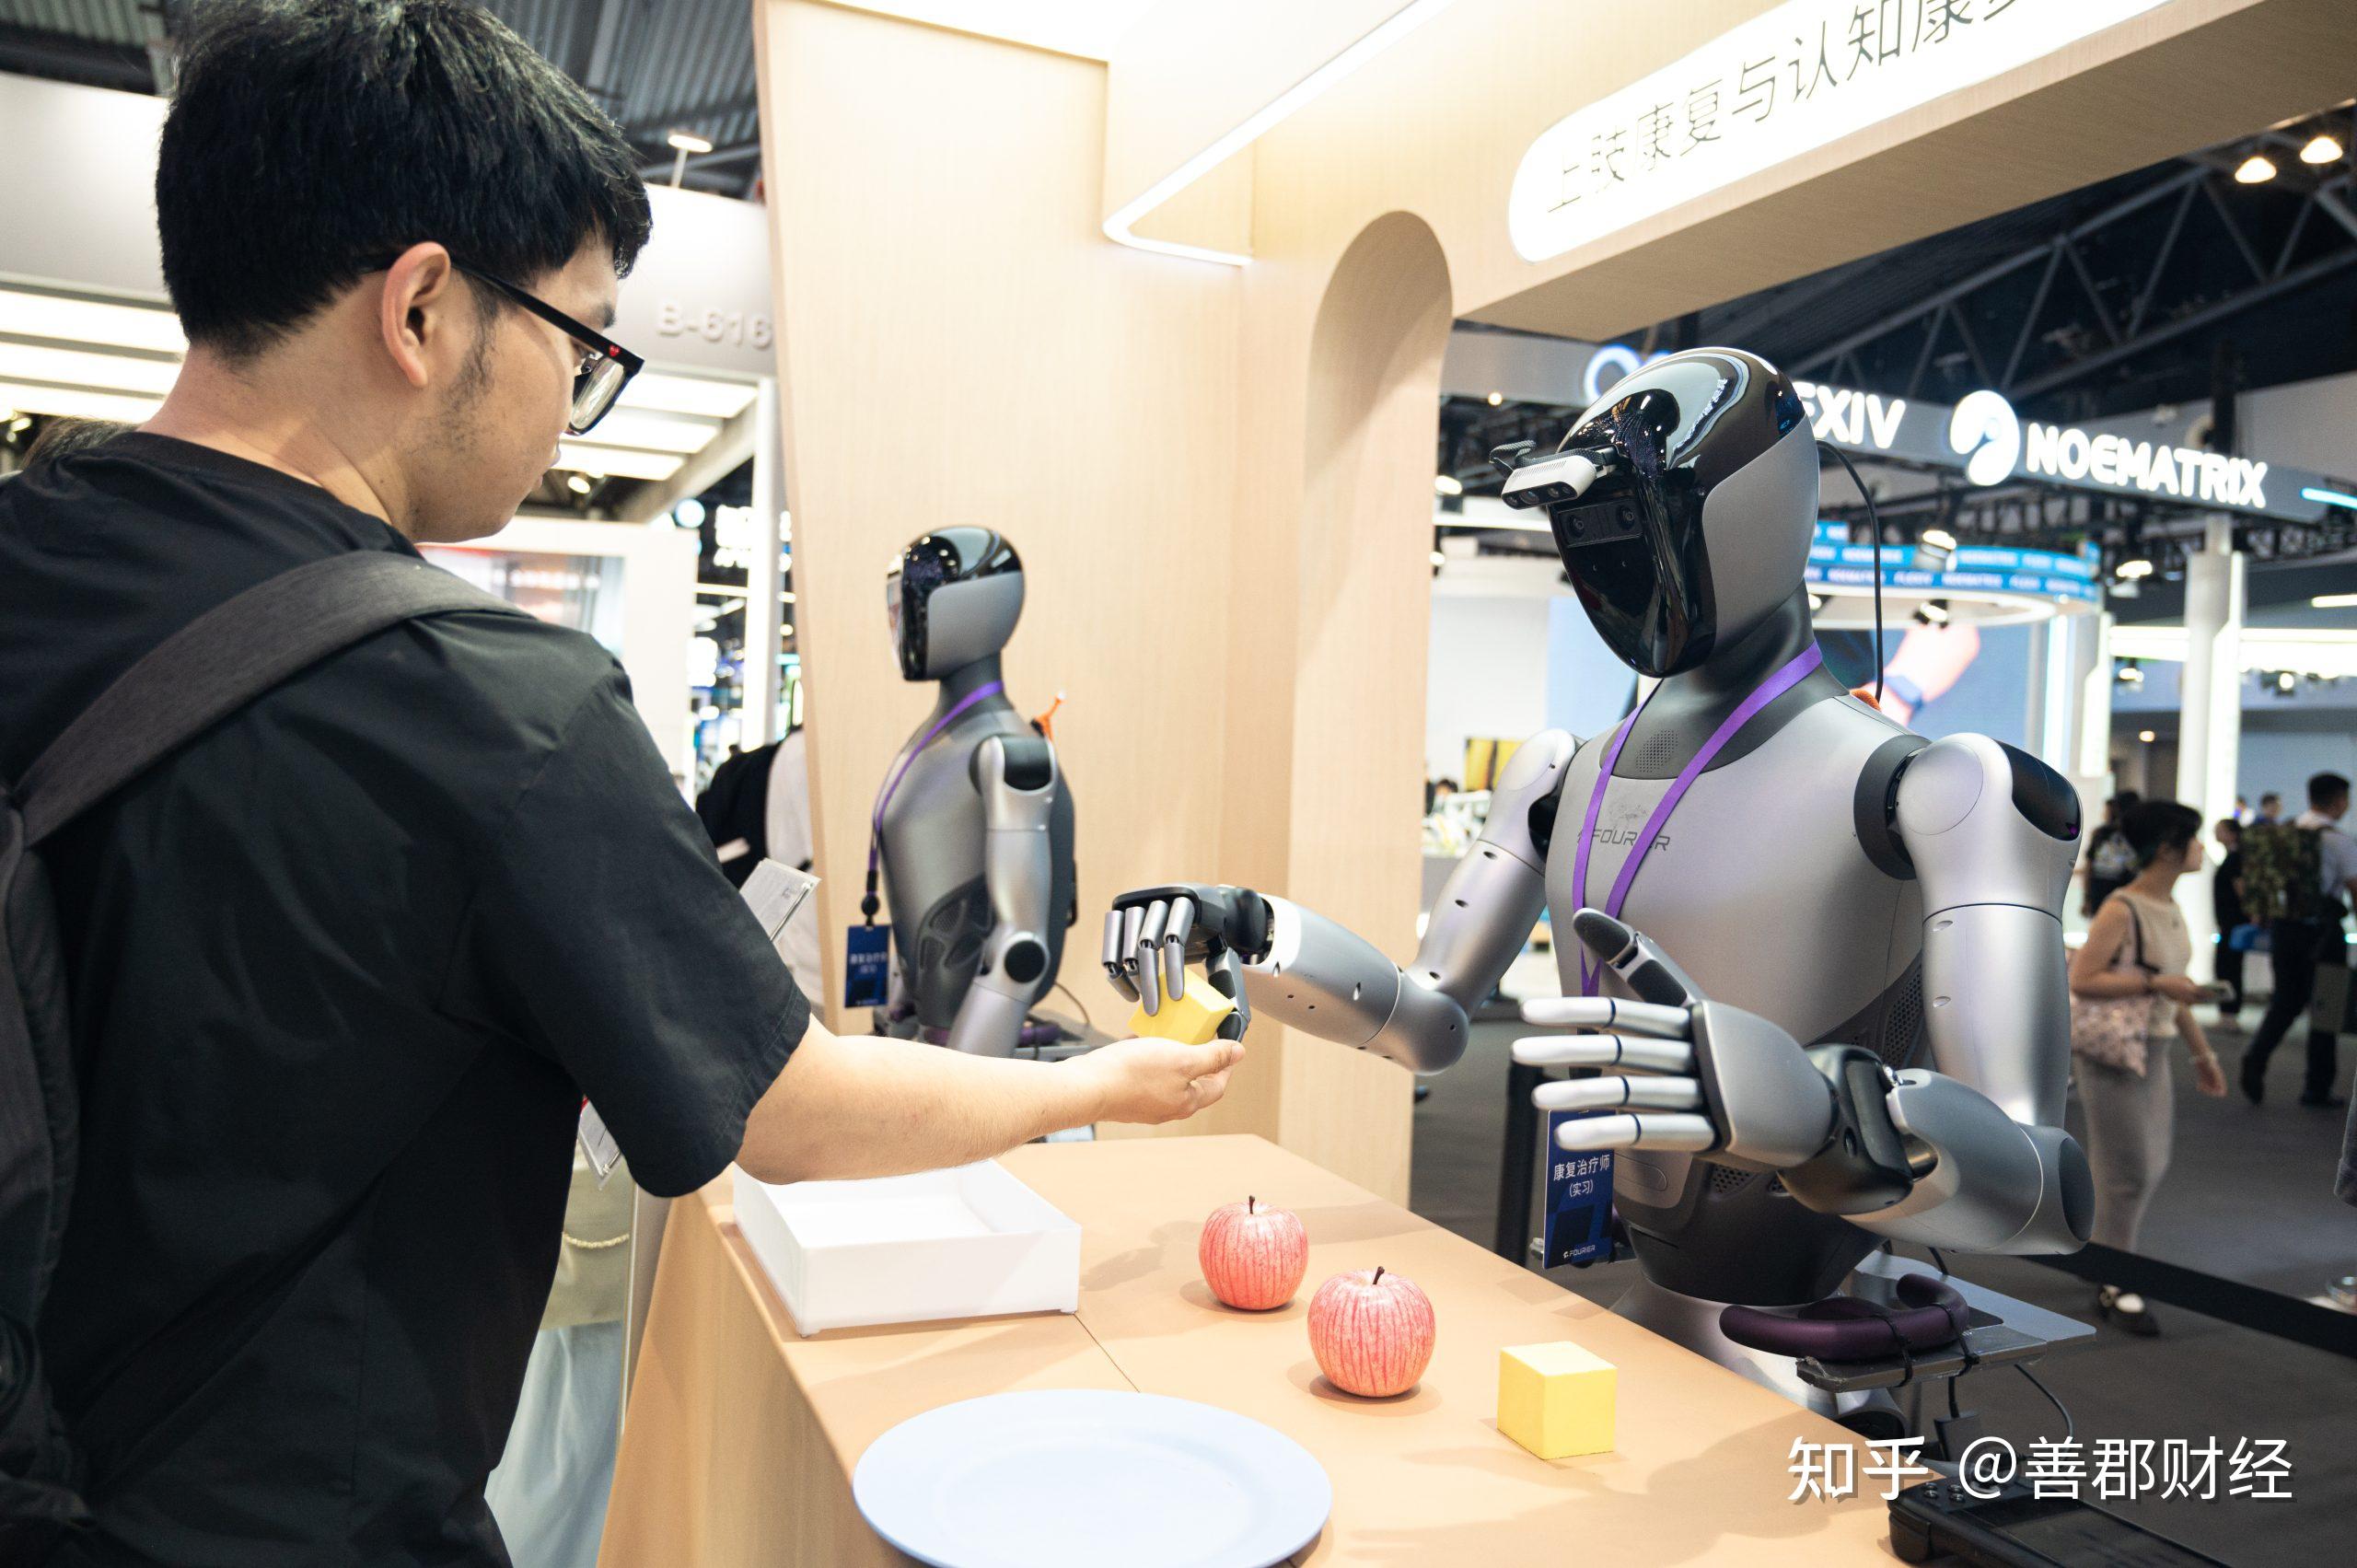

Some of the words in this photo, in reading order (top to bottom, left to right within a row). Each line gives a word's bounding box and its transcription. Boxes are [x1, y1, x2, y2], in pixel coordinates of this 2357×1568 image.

[656, 298, 772, 350] B-616
[2026, 423, 2268, 508] NOEMATRIX
[1592, 829, 1670, 851] FOURR
[1553, 1154, 1610, 1181] 康复治疗师
[1569, 1179, 1594, 1198] (实习)
